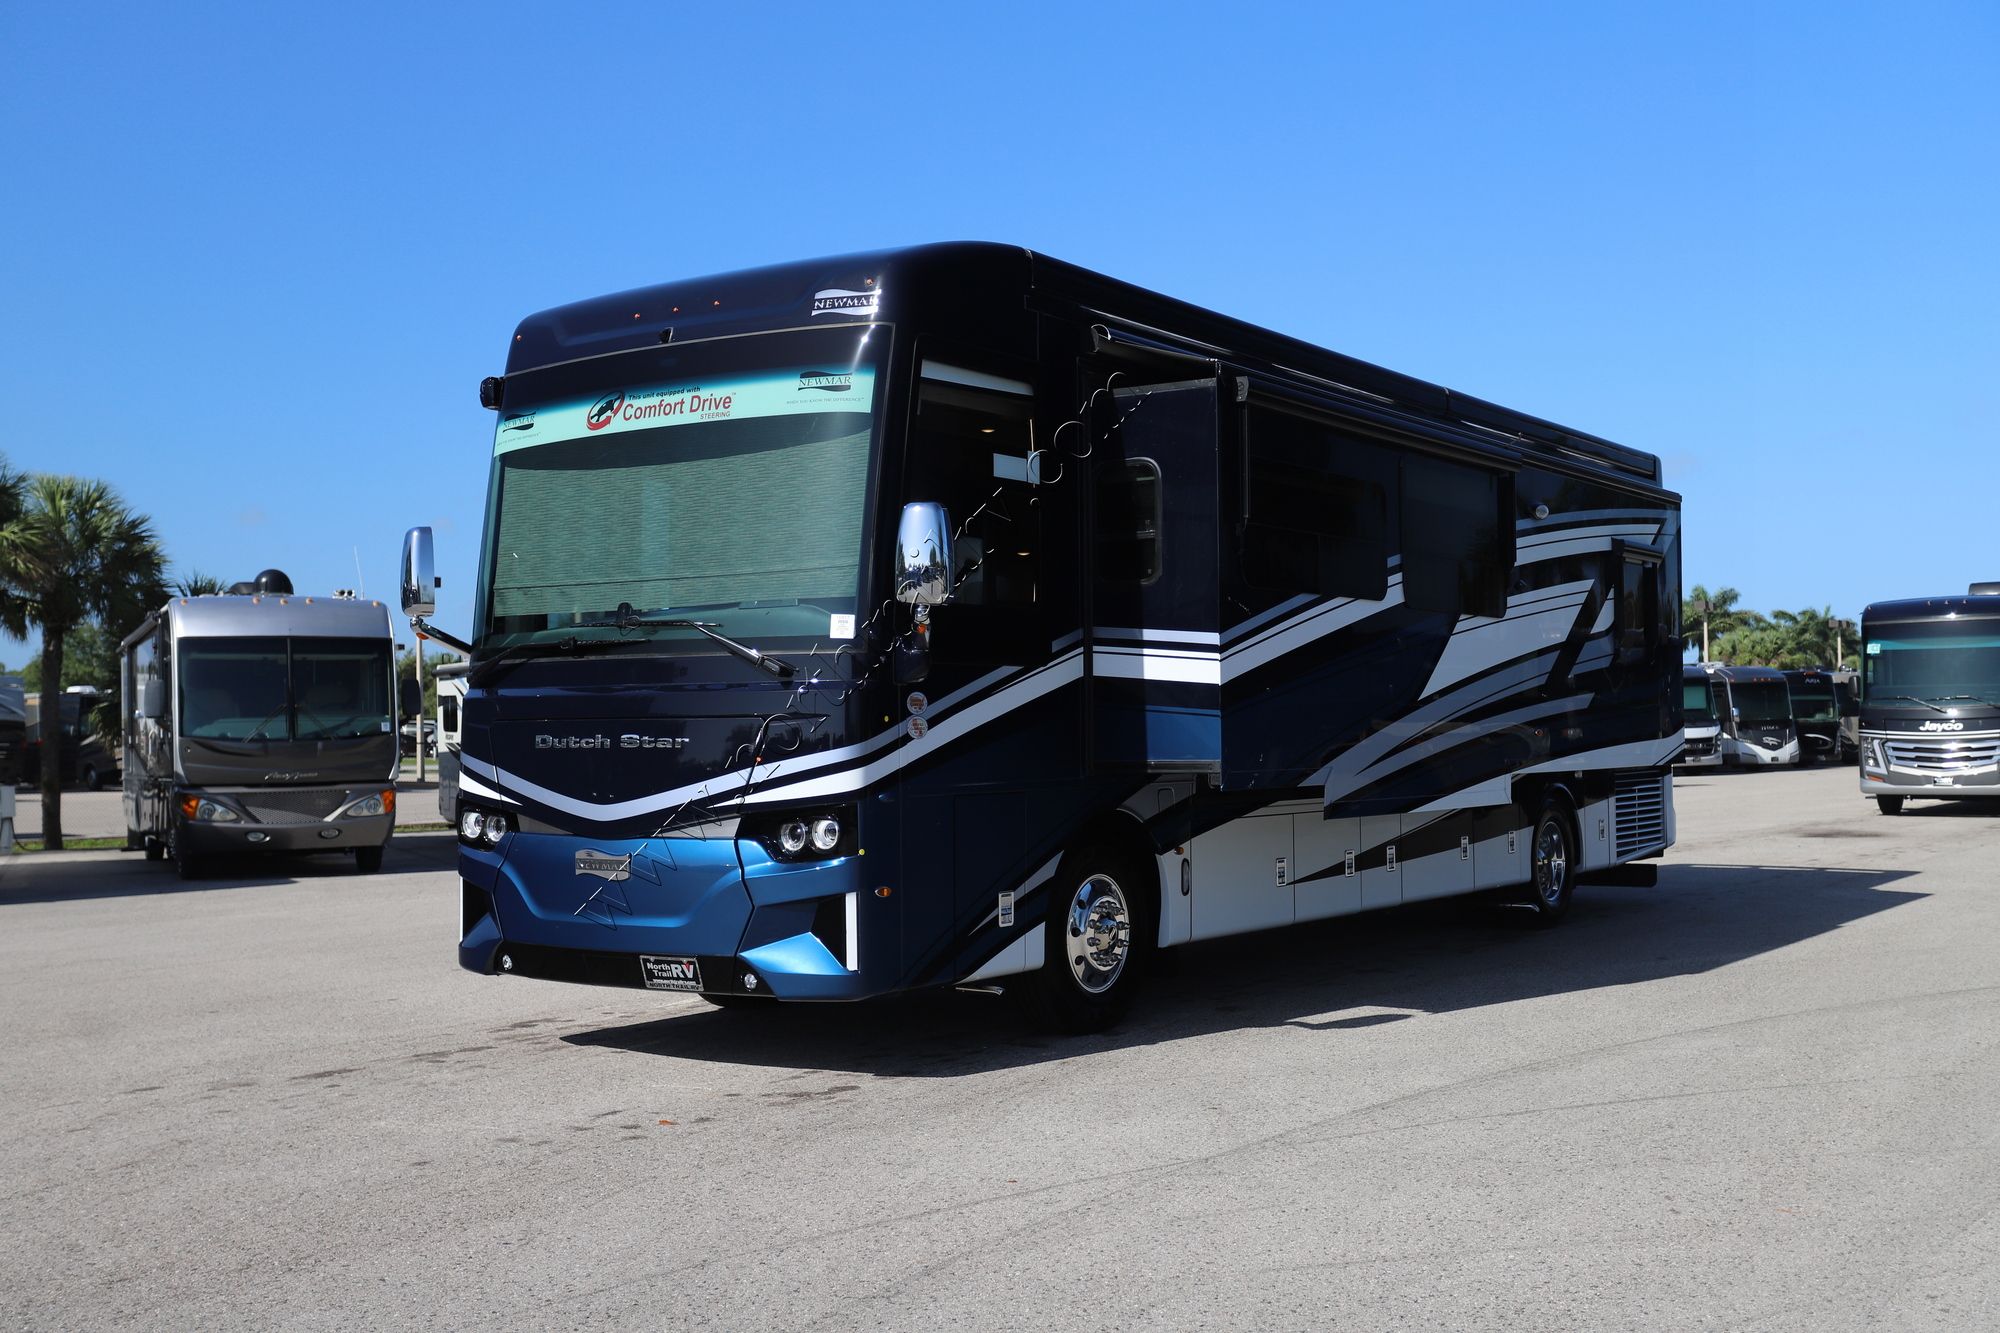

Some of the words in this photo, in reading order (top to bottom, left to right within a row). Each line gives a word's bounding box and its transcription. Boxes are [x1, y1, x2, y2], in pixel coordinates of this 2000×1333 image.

[799, 376, 852, 387] NEWMAR
[656, 388, 684, 398] equipped
[623, 397, 684, 421] Comfort
[689, 394, 732, 413] Drive
[700, 411, 731, 420] STEERING
[1918, 720, 1964, 732] Jayco
[535, 733, 611, 749] Dutch
[620, 733, 690, 749] Star
[647, 962, 671, 971] North
[671, 964, 694, 979] RV
[652, 969, 672, 978] Trail
